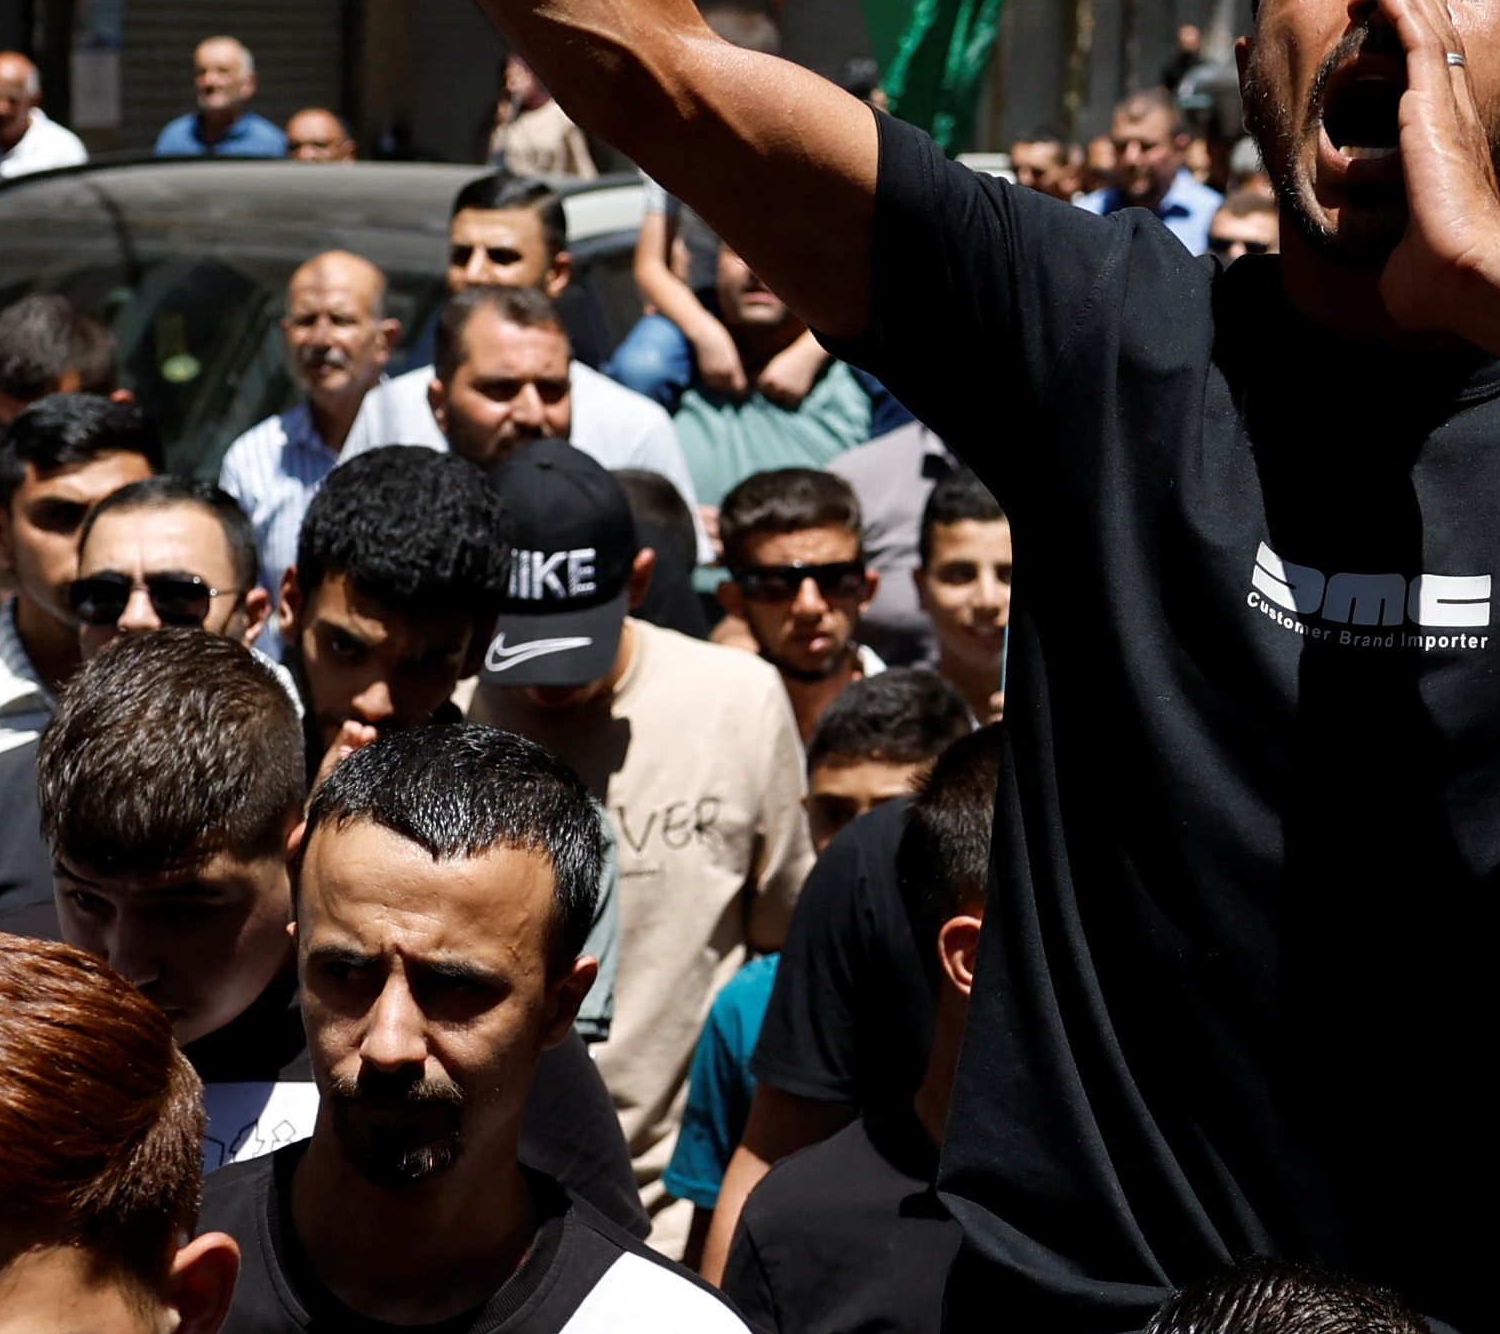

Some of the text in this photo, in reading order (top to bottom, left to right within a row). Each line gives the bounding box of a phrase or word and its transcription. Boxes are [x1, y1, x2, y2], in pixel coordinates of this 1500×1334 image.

[1246, 591, 1490, 653] Customer Brand Importer
